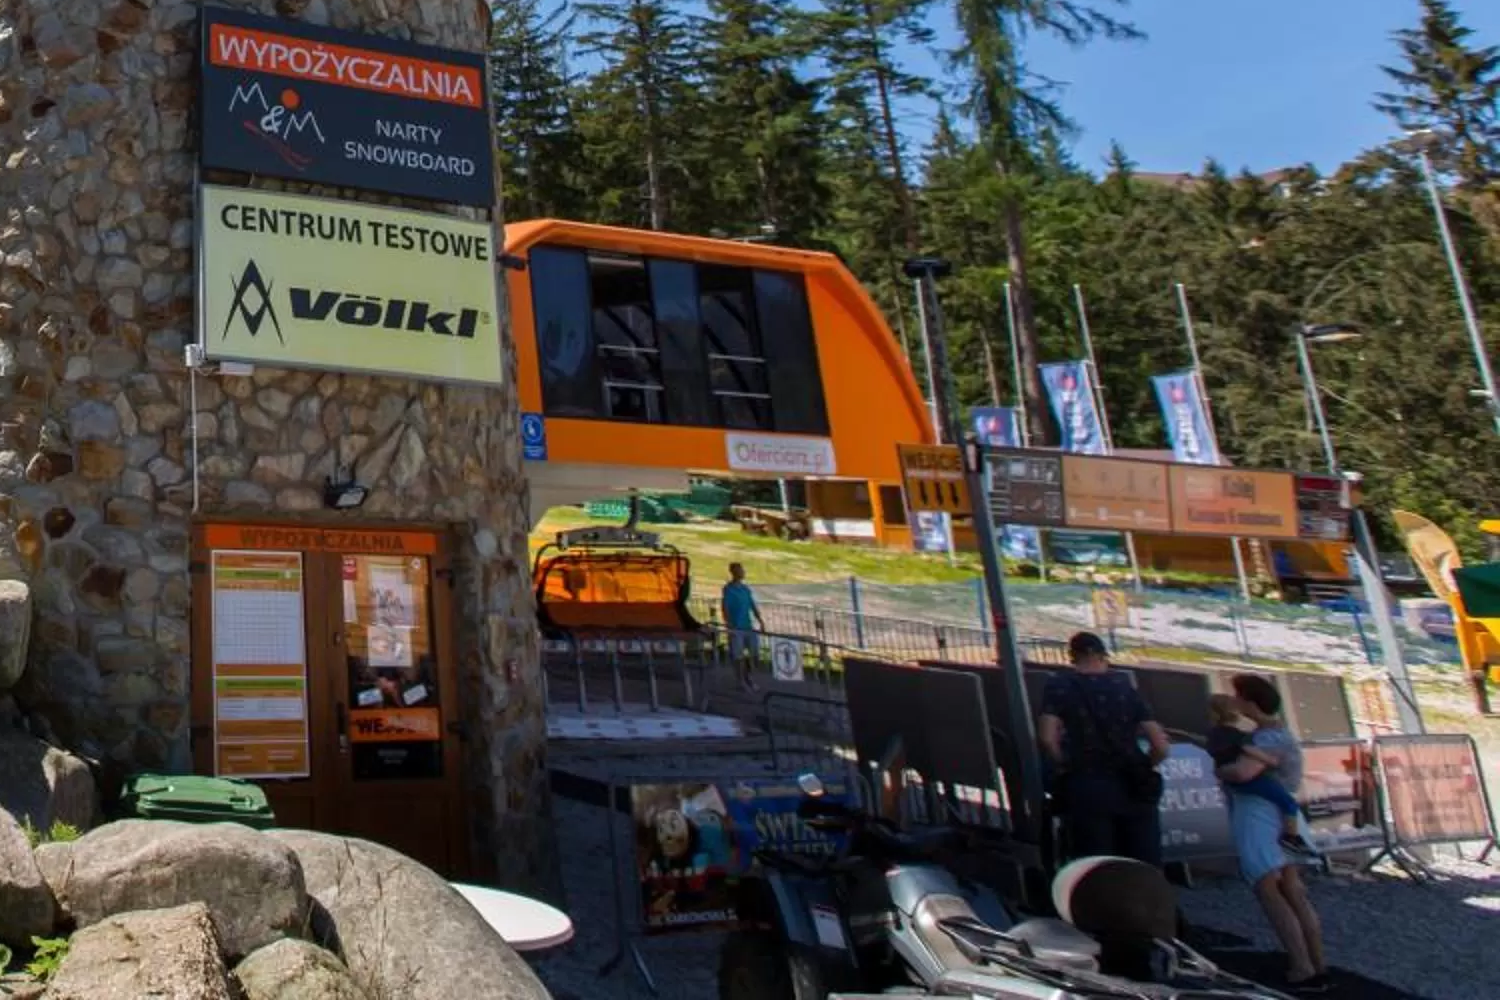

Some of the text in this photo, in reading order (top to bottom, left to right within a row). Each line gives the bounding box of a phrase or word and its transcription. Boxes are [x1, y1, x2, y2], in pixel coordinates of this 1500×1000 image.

[218, 34, 475, 104] WYPOŻYCZALNIA
[374, 118, 443, 146] NARTY
[344, 140, 476, 177] SNOWBOARD
[220, 203, 489, 262] CENTRUM TESTOWE
